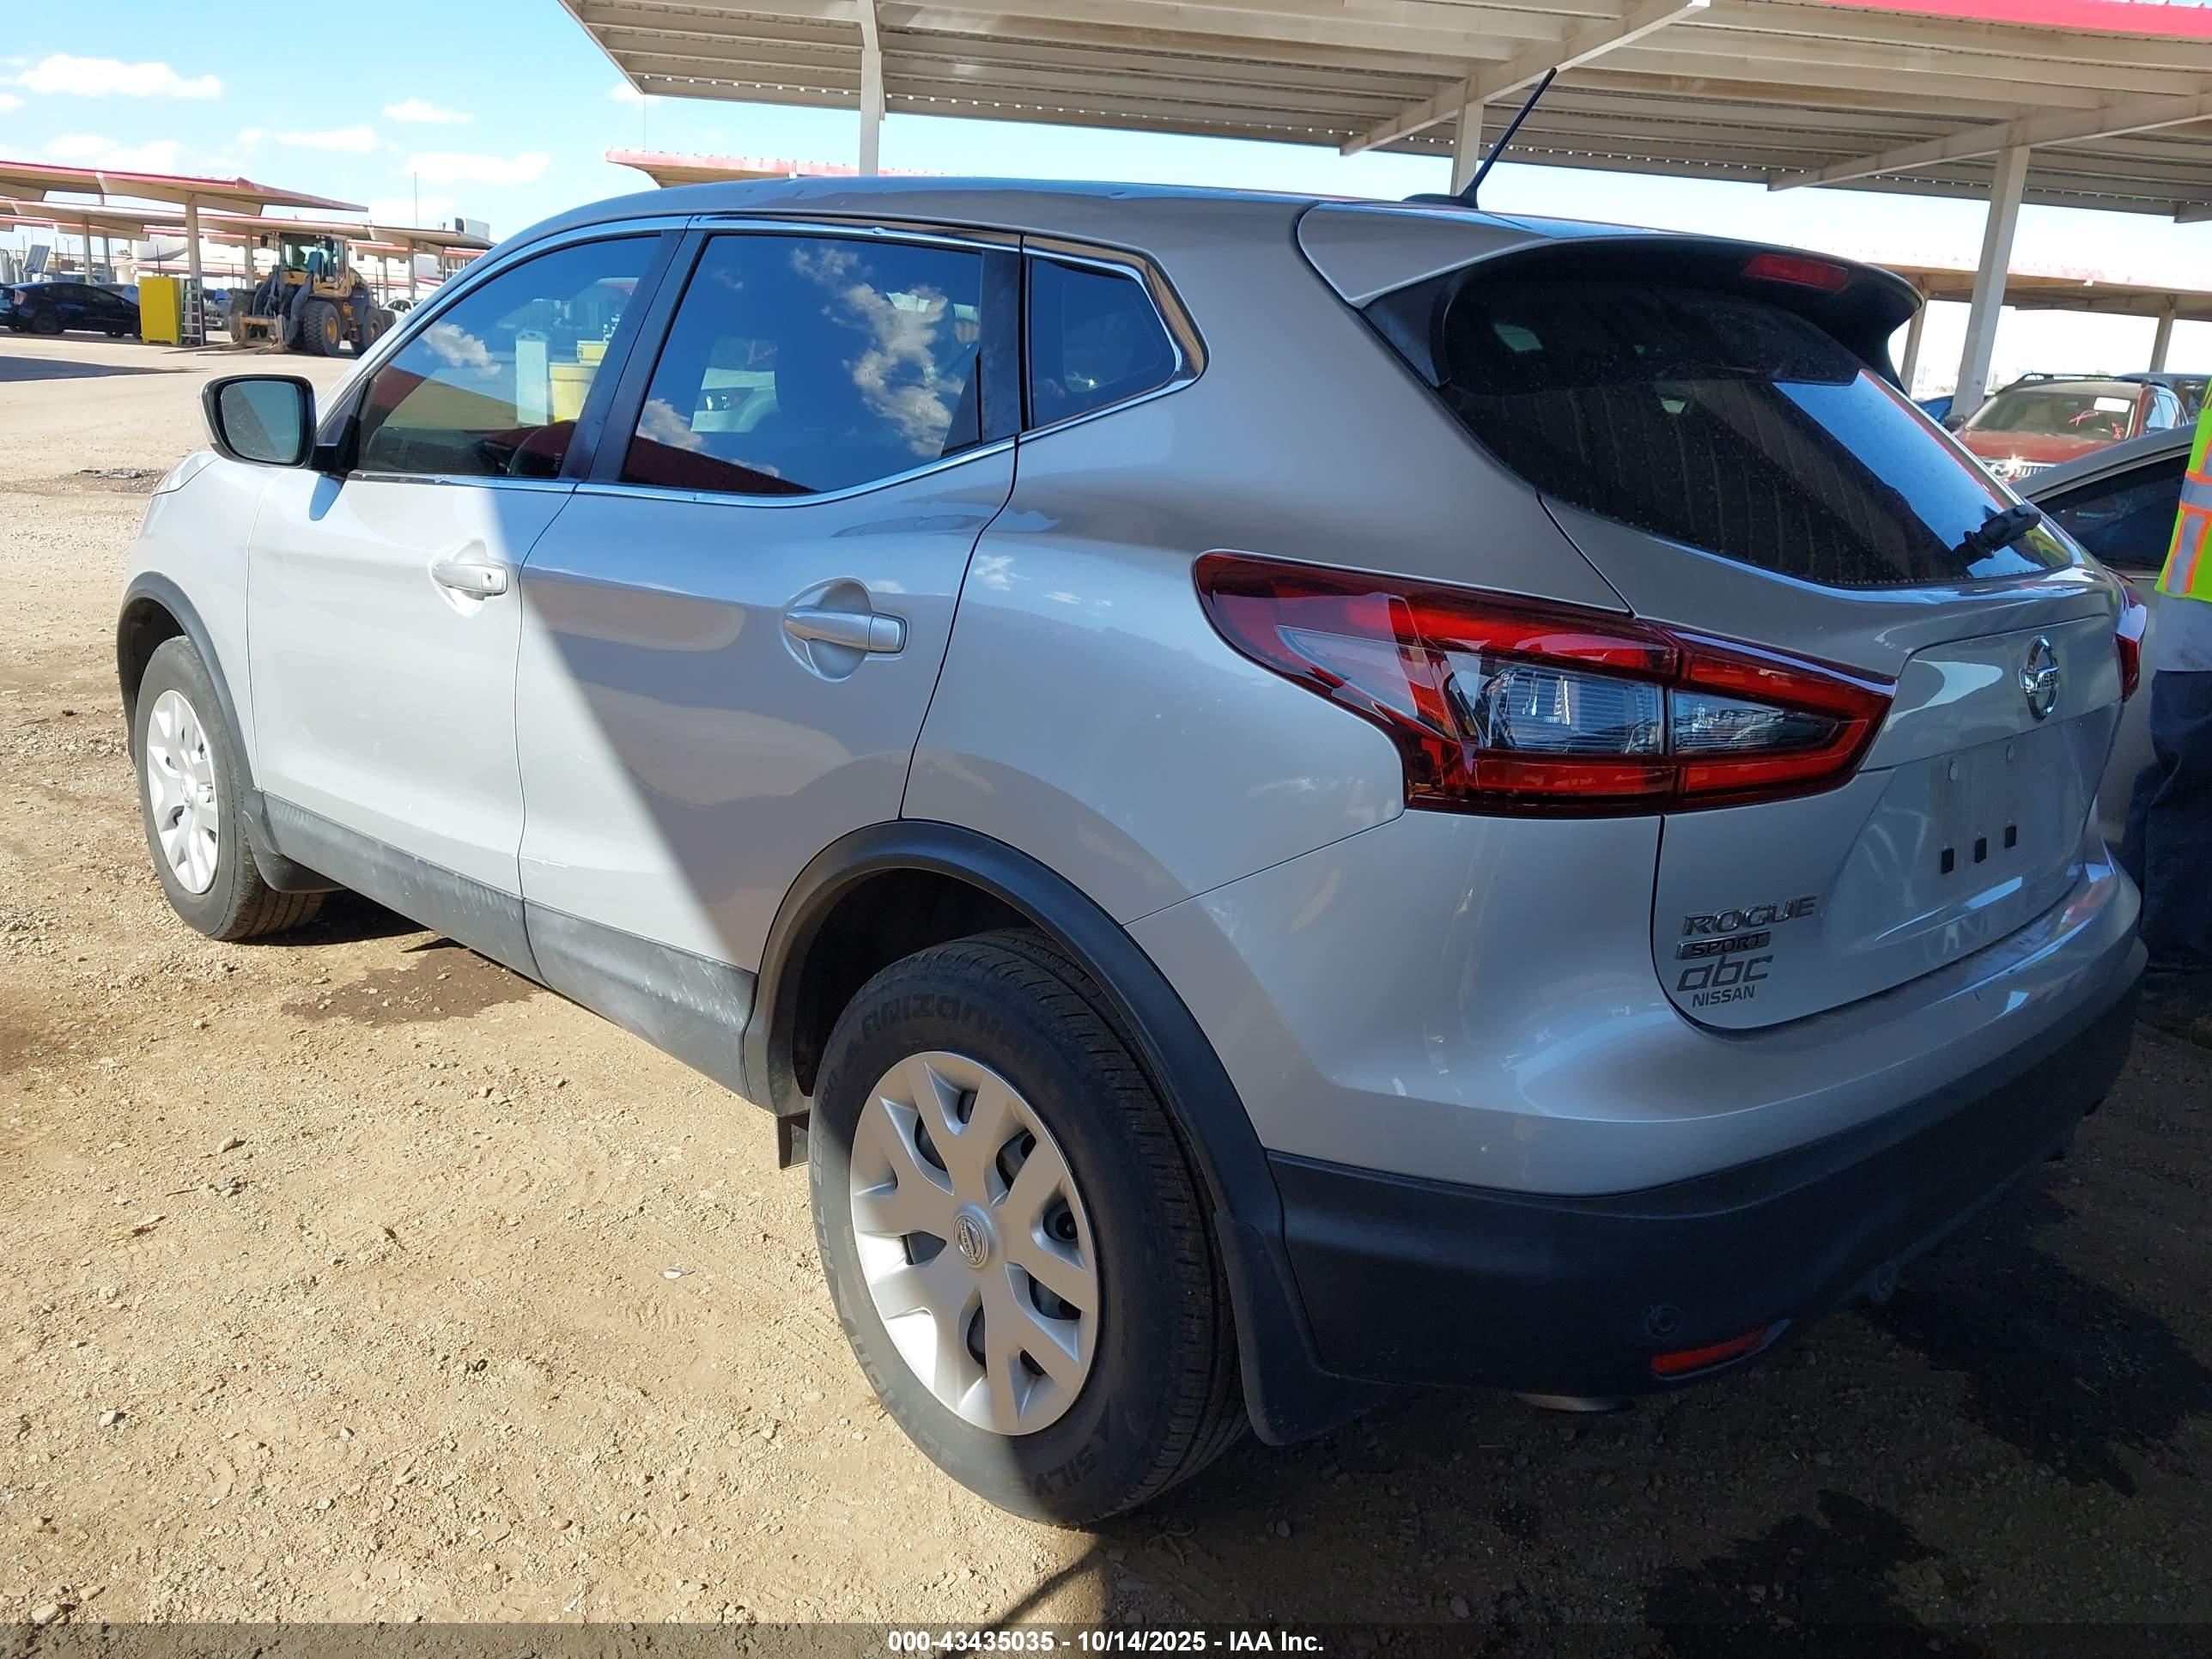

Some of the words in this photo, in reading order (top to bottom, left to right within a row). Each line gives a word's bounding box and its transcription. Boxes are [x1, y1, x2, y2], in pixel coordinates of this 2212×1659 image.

[1682, 895, 1817, 936] ROGUE
[1691, 932, 1763, 957] SPORT
[1692, 985, 1755, 1008] NISSAN
[960, 1221, 974, 1259] NISSAN
